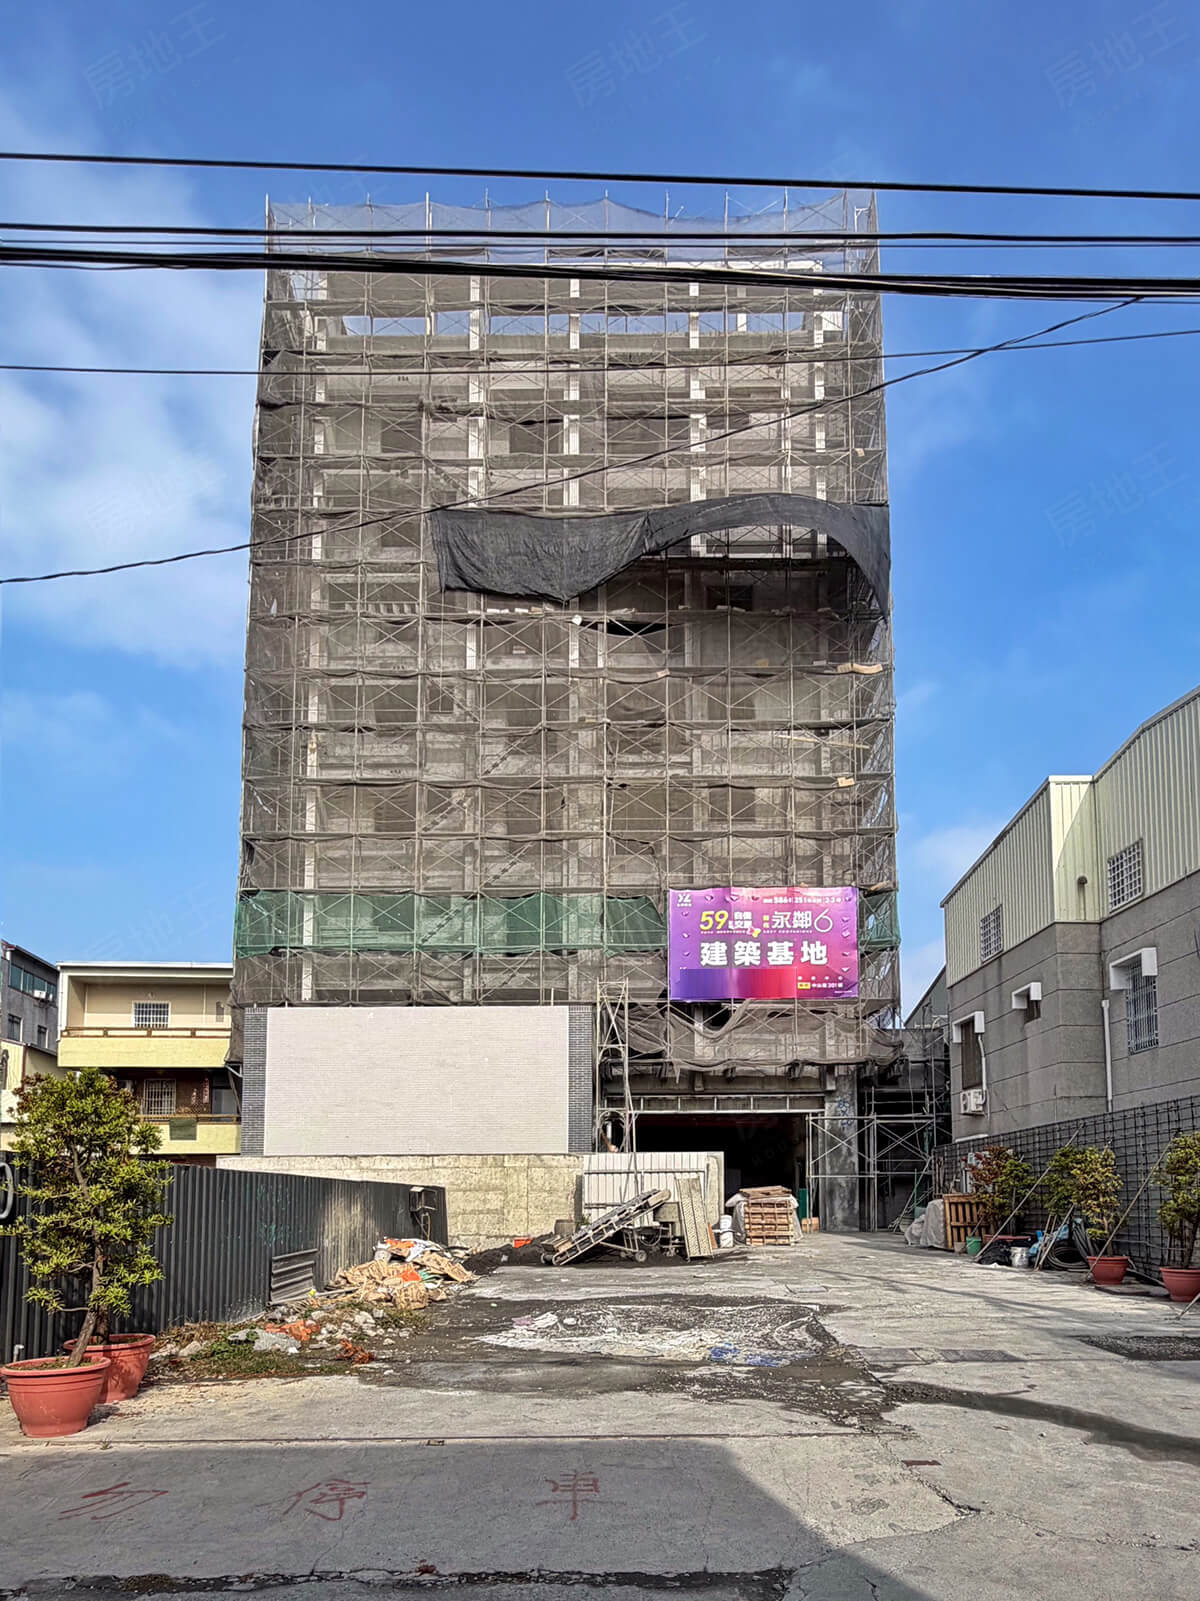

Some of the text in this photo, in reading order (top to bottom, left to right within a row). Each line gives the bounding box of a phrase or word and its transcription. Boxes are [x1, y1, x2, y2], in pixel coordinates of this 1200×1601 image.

[700, 910, 728, 930] 59
[700, 940, 828, 966] 建築基地
